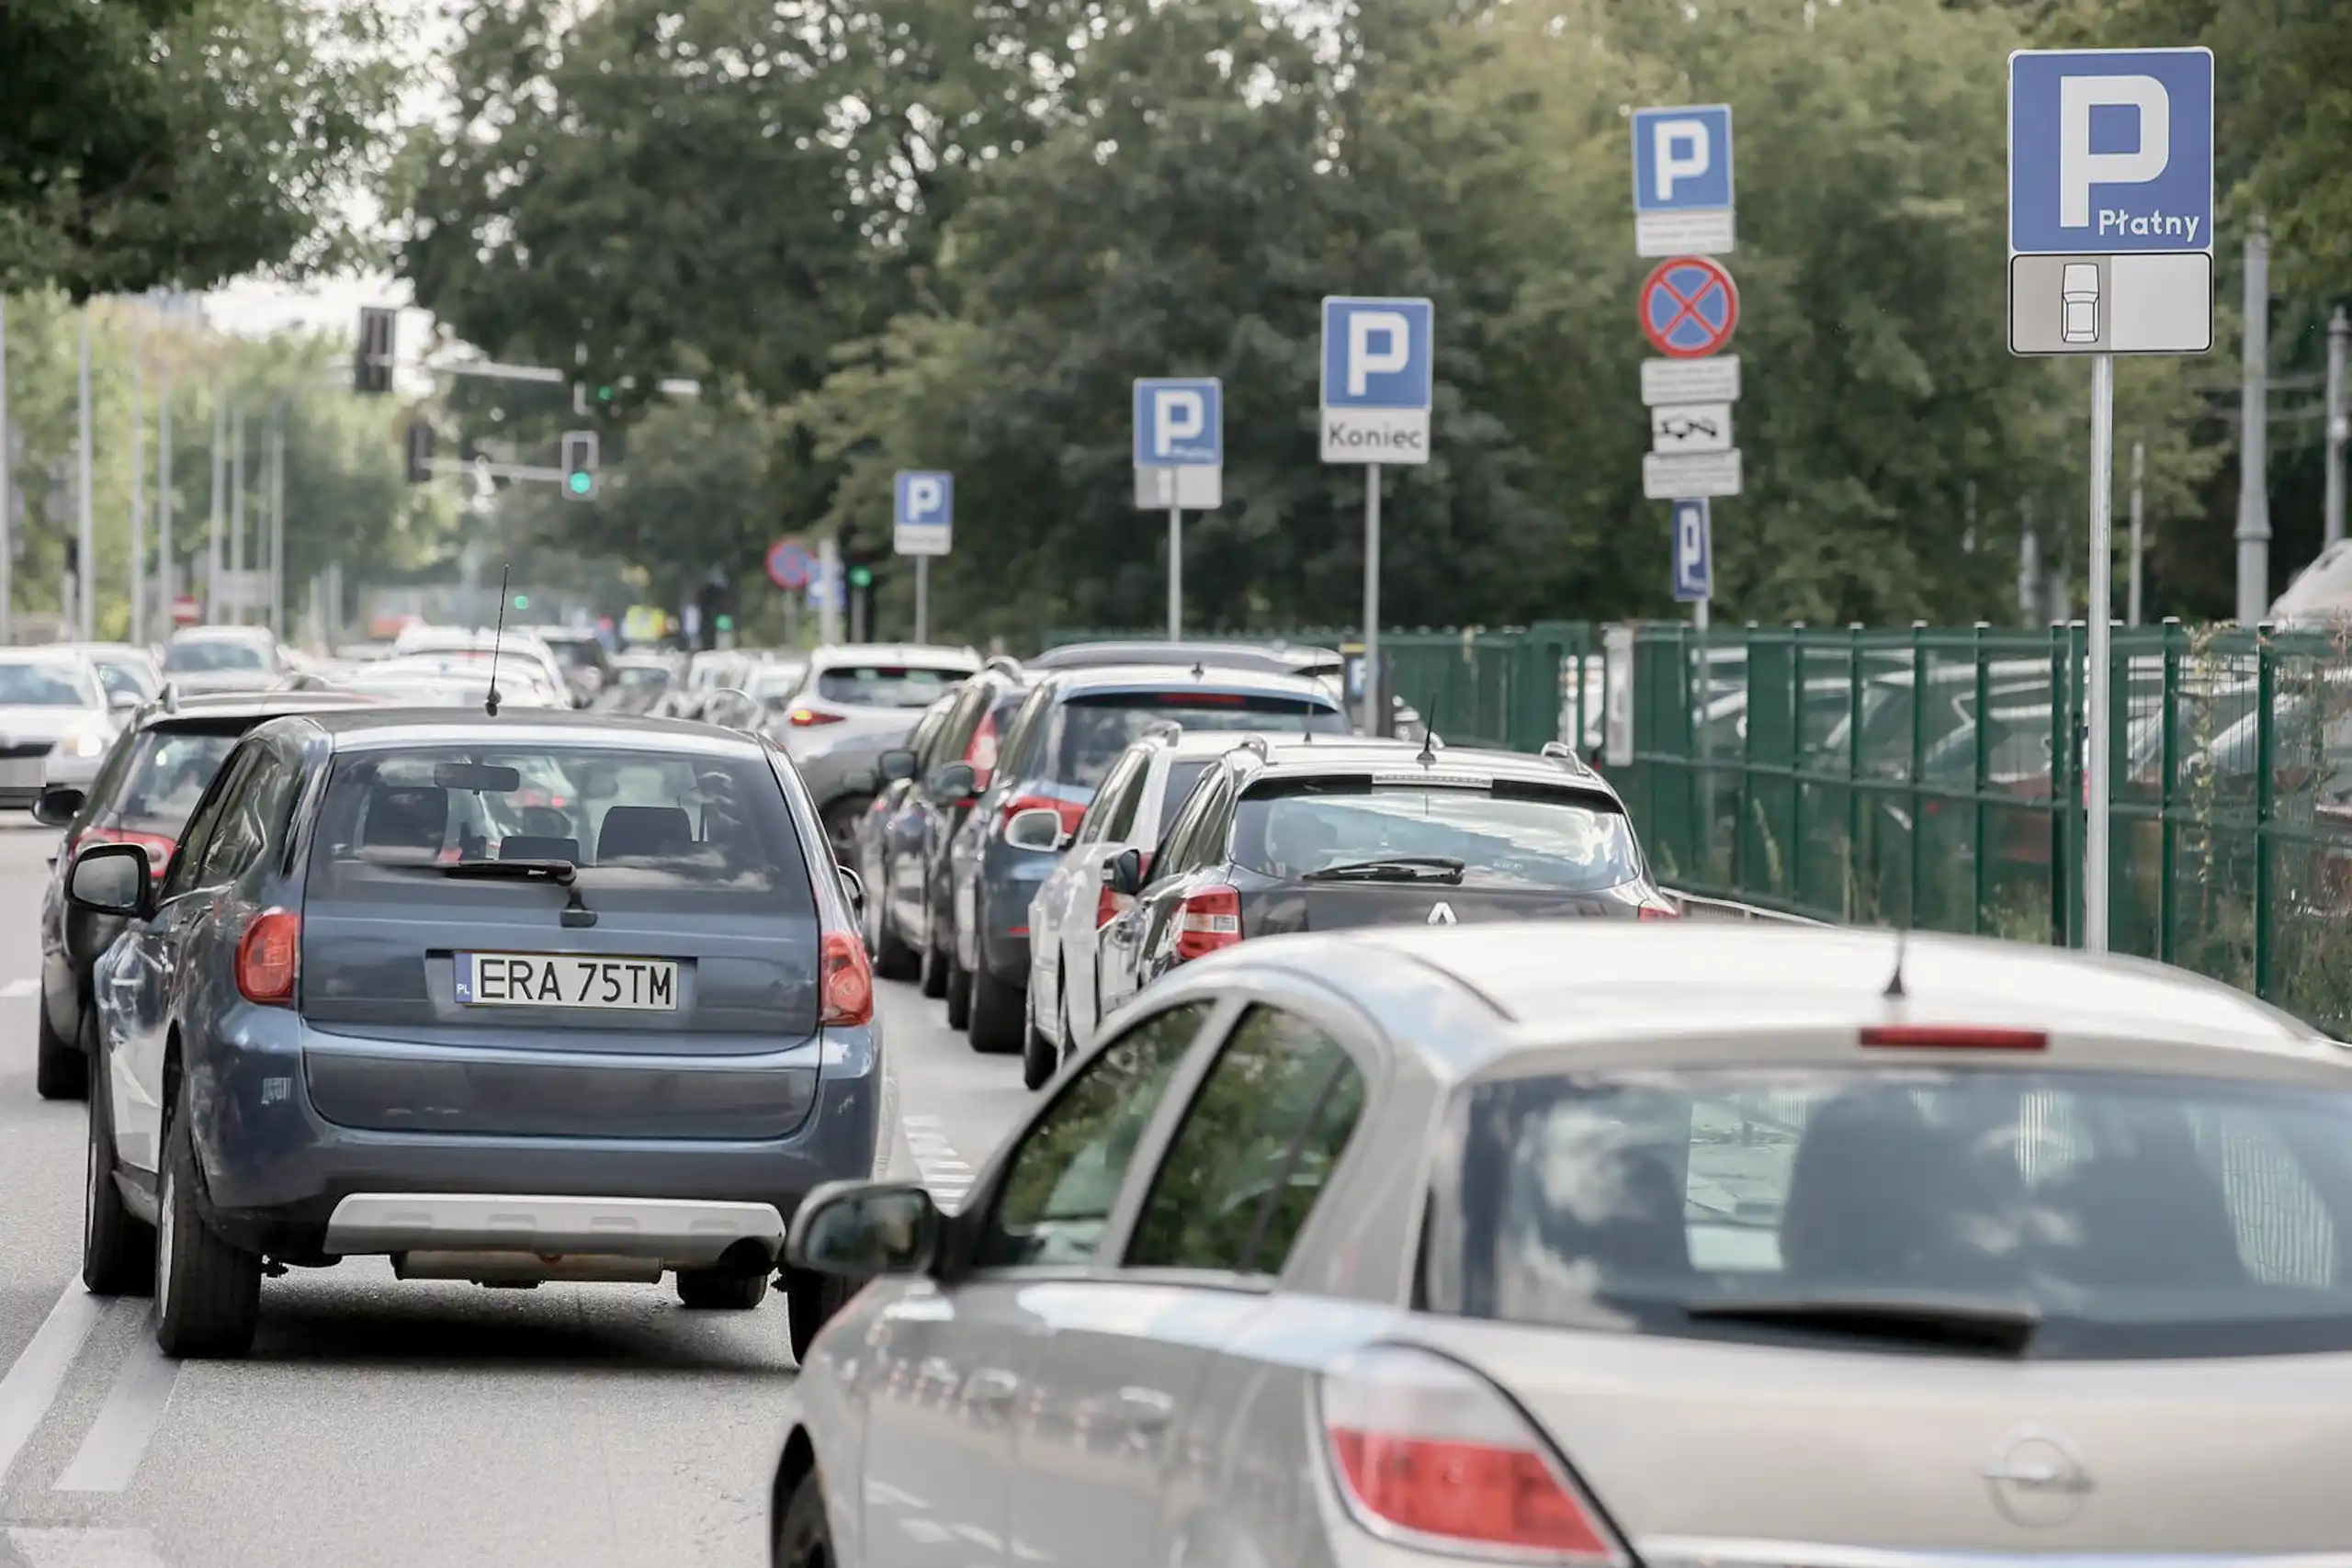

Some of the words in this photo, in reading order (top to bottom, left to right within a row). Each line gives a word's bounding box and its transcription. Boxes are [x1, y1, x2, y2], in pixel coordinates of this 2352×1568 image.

[1654, 119, 1710, 201] P
[2060, 75, 2169, 228] P
[2098, 209, 2199, 243] Płatny
[1348, 310, 1409, 397] P
[1155, 389, 1204, 457] P
[1329, 421, 1422, 449] Koniec
[908, 478, 942, 522] P
[1679, 507, 1701, 588] P
[457, 983, 470, 995] PL
[480, 959, 562, 1001] ERA
[577, 963, 671, 1005] 75TM
